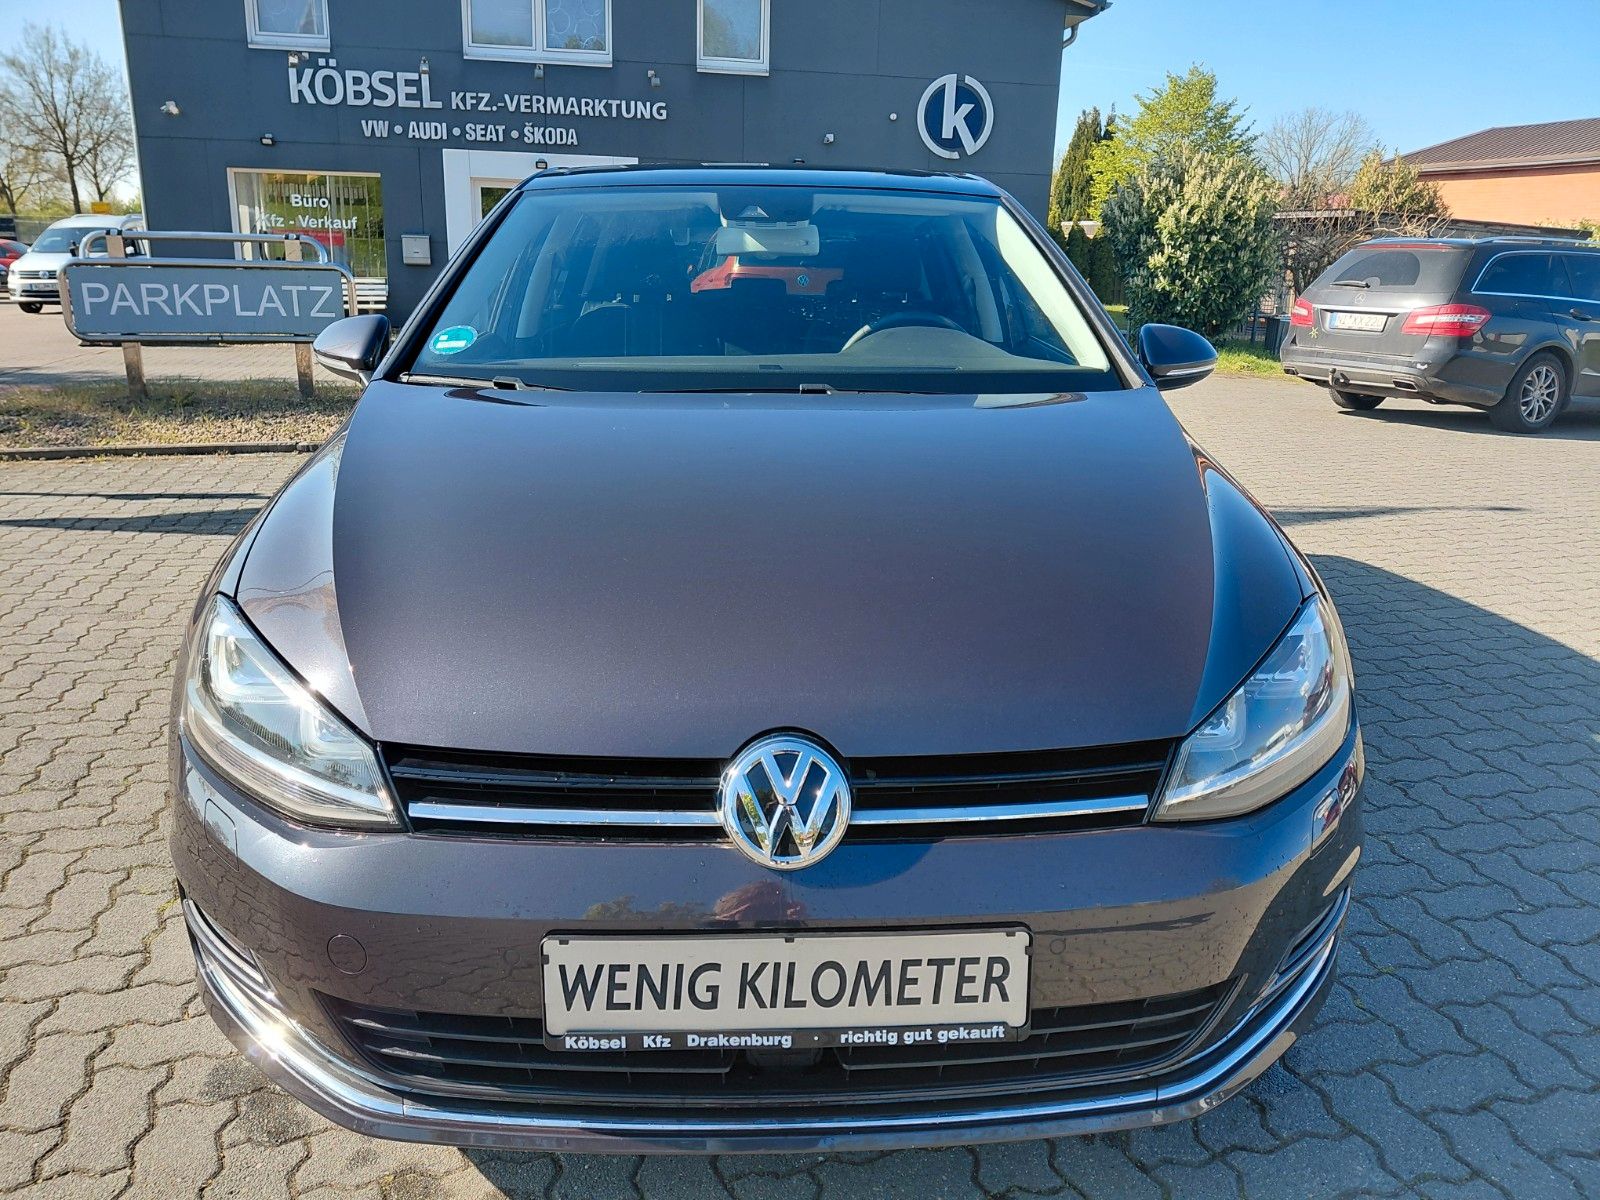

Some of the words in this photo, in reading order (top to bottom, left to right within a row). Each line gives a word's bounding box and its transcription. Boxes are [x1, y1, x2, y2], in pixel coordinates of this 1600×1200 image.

[288, 58, 443, 109] KÖBSEL
[451, 91, 668, 120] KFZ.-VERMARKTUNG
[361, 119, 389, 138] VW
[408, 121, 448, 140] AUDI
[465, 122, 506, 142] SEAT
[523, 122, 578, 146] ŠKODA
[291, 194, 329, 209] Büro
[260, 214, 285, 228] Kfz
[298, 214, 358, 230] Verkauf
[81, 282, 336, 318] PARKPLATZ
[558, 962, 722, 1012] WENIG
[737, 955, 1011, 1010] KILOMETER
[565, 1035, 627, 1050] Köbsel
[643, 1035, 672, 1048] Kfz
[687, 1033, 793, 1048] Drakenburg
[840, 1029, 898, 1045] richtig
[903, 1028, 933, 1044] gut
[937, 1026, 1005, 1043] gekauft
